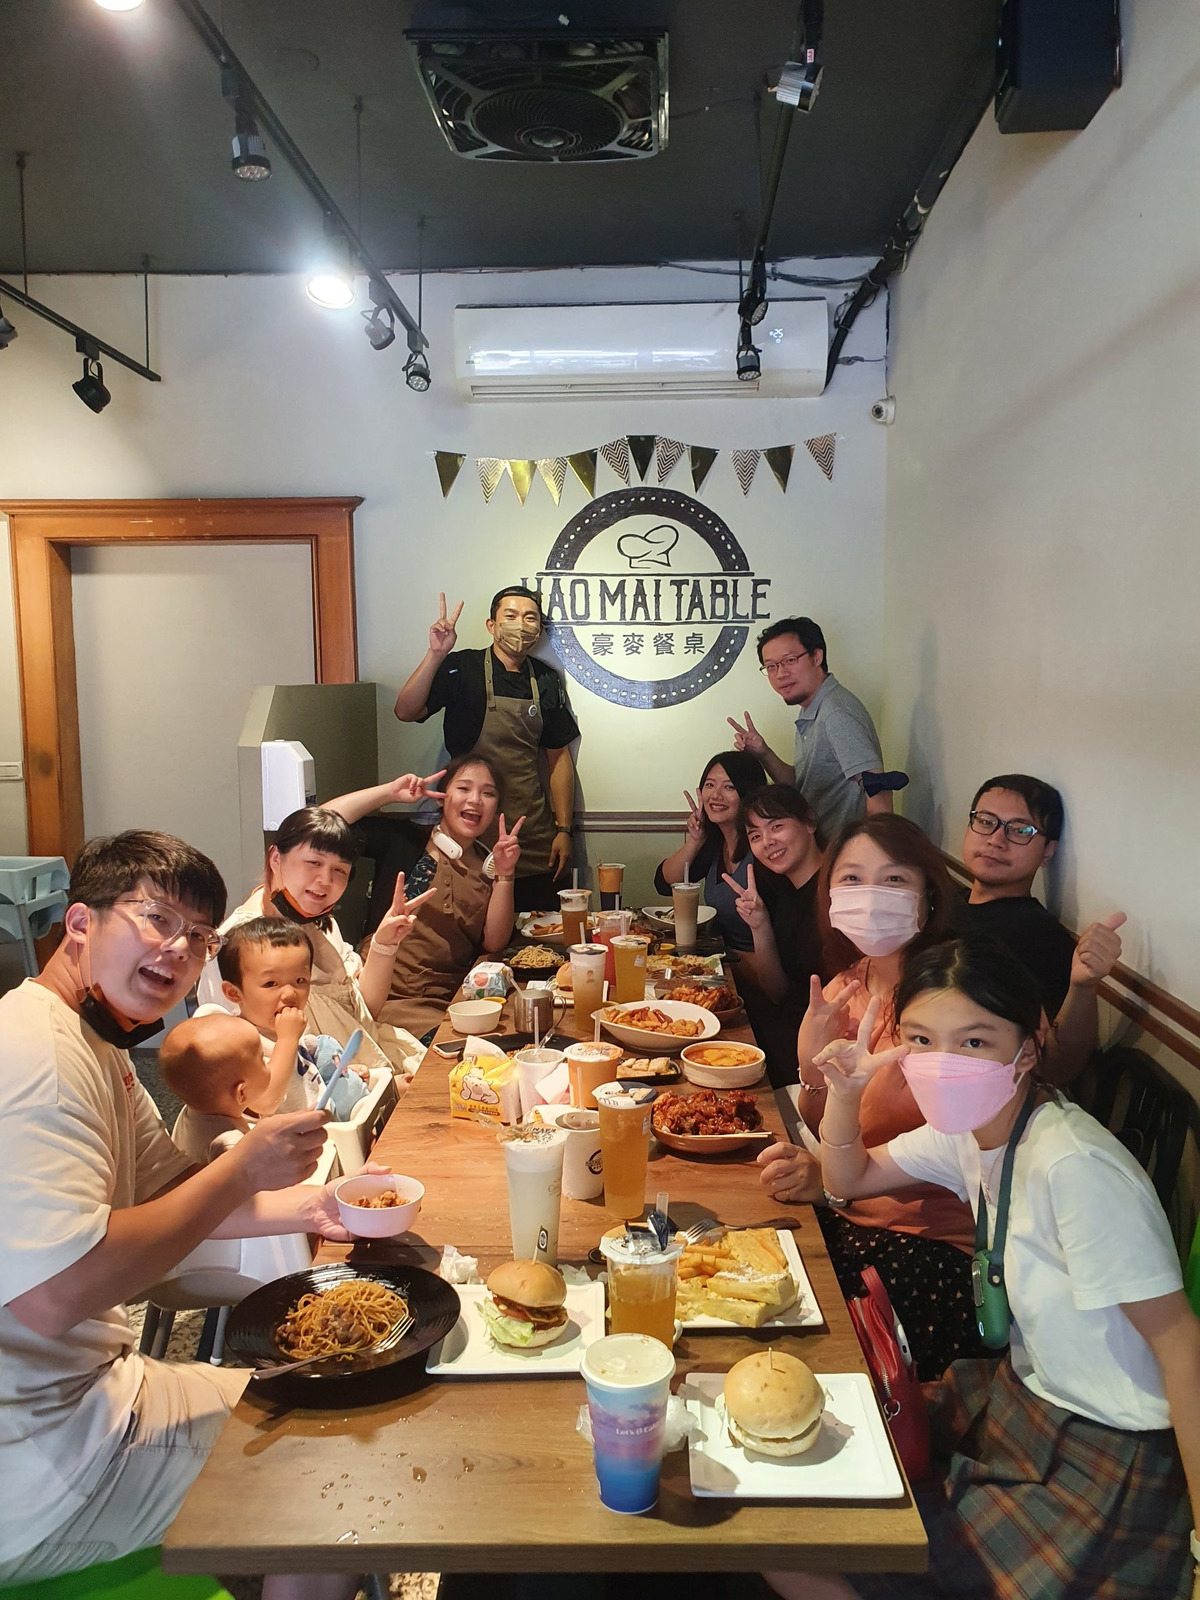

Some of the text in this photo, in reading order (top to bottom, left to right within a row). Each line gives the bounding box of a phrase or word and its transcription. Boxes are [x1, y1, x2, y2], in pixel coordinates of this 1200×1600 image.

[599, 579, 662, 621] MAI
[669, 579, 772, 621] TABLE
[591, 632, 705, 656] 豪麥餐桌
